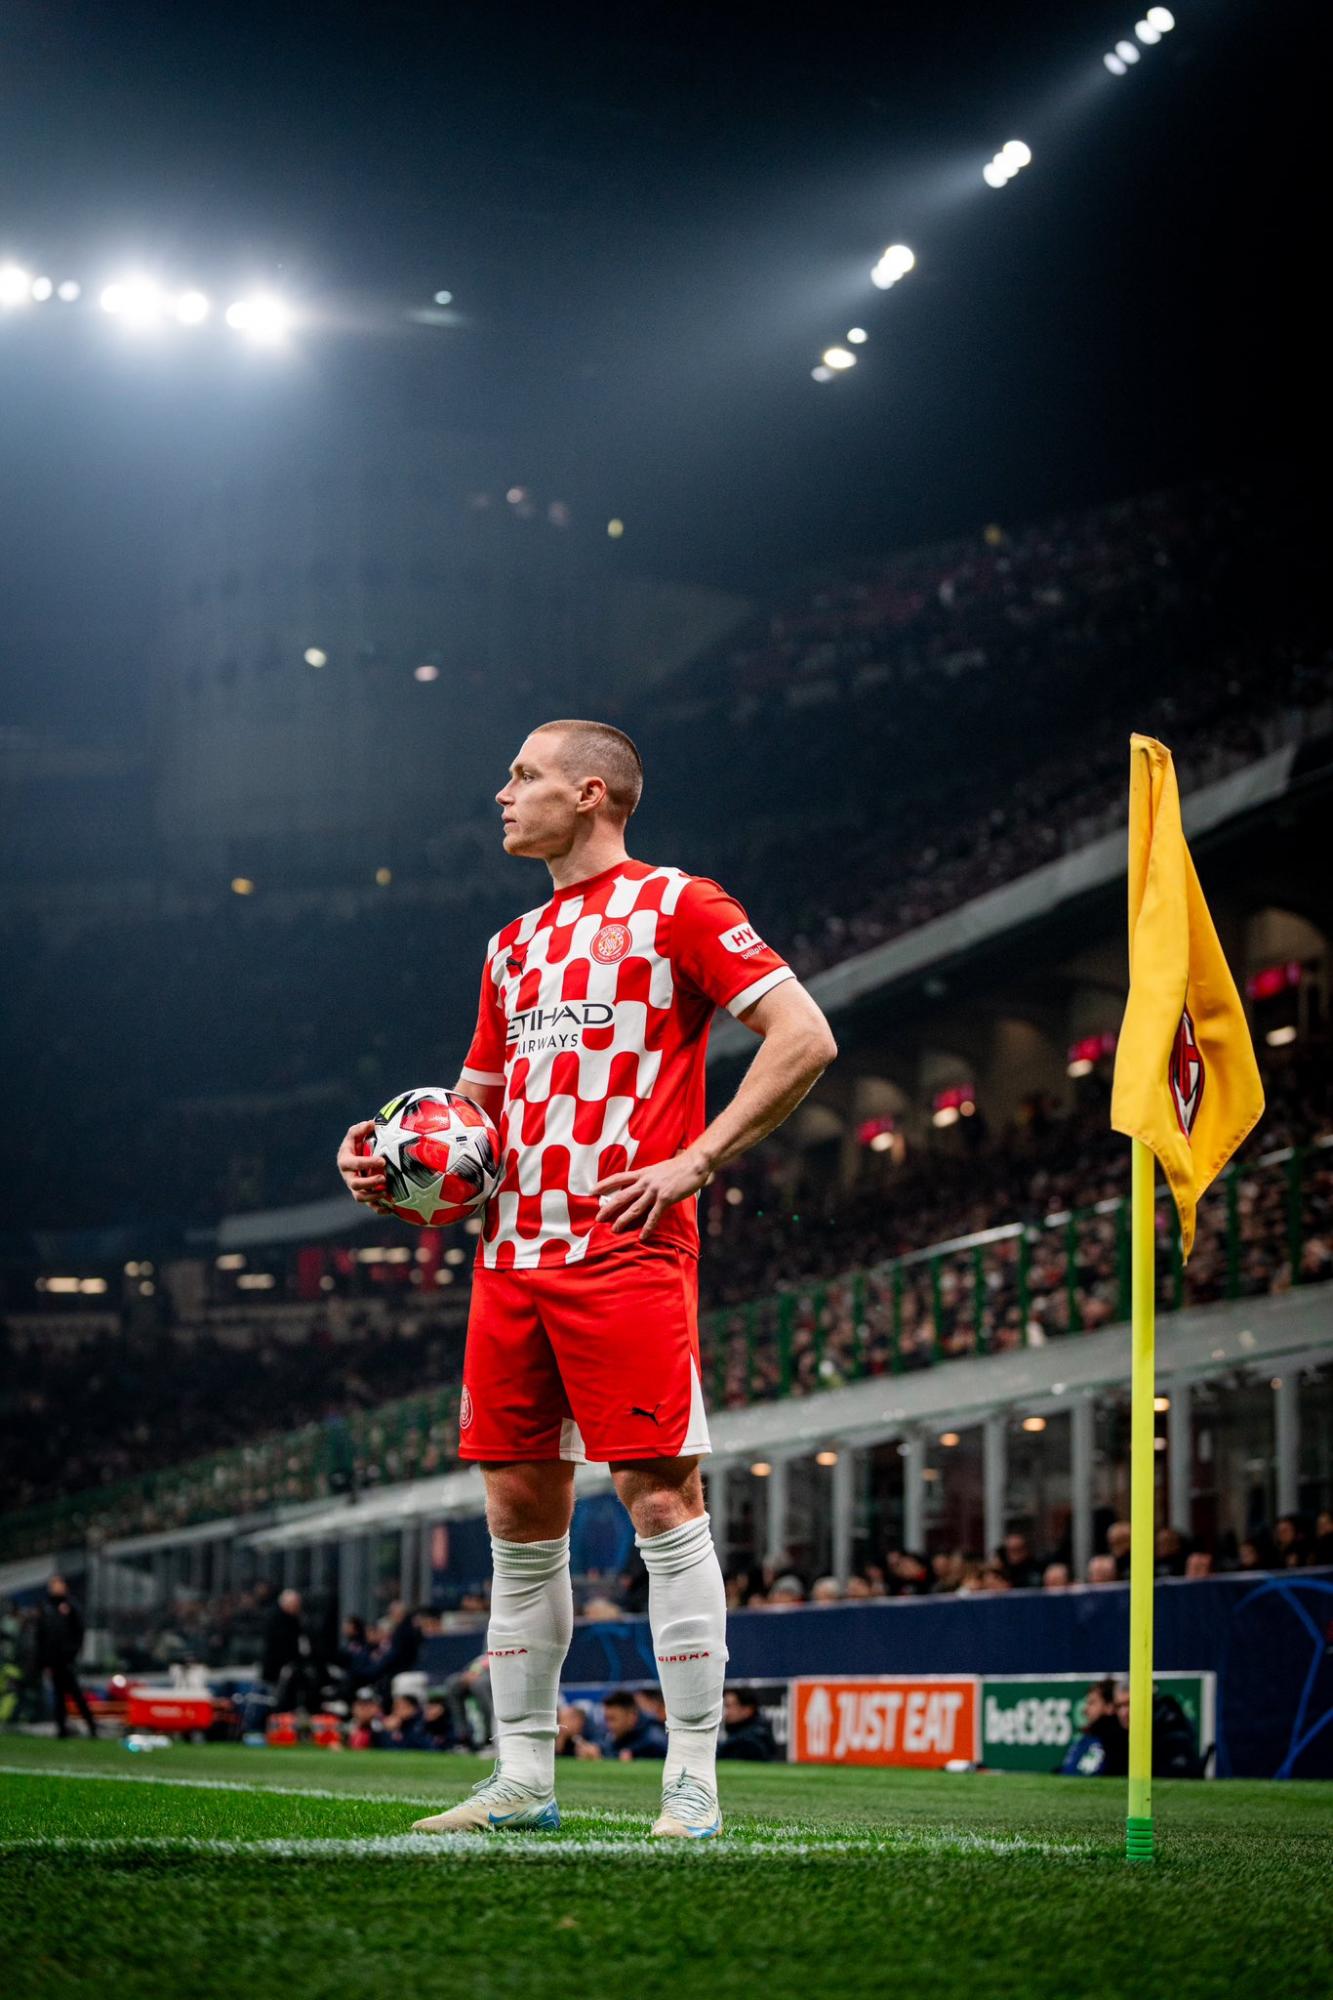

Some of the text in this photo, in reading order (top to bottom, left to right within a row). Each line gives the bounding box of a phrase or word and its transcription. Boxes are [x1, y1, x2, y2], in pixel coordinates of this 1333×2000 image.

[658, 1651, 710, 1662] GIRONA
[834, 1691, 904, 1758] JUST
[904, 1692, 963, 1753] EAT
[985, 1696, 1072, 1745] bet365
